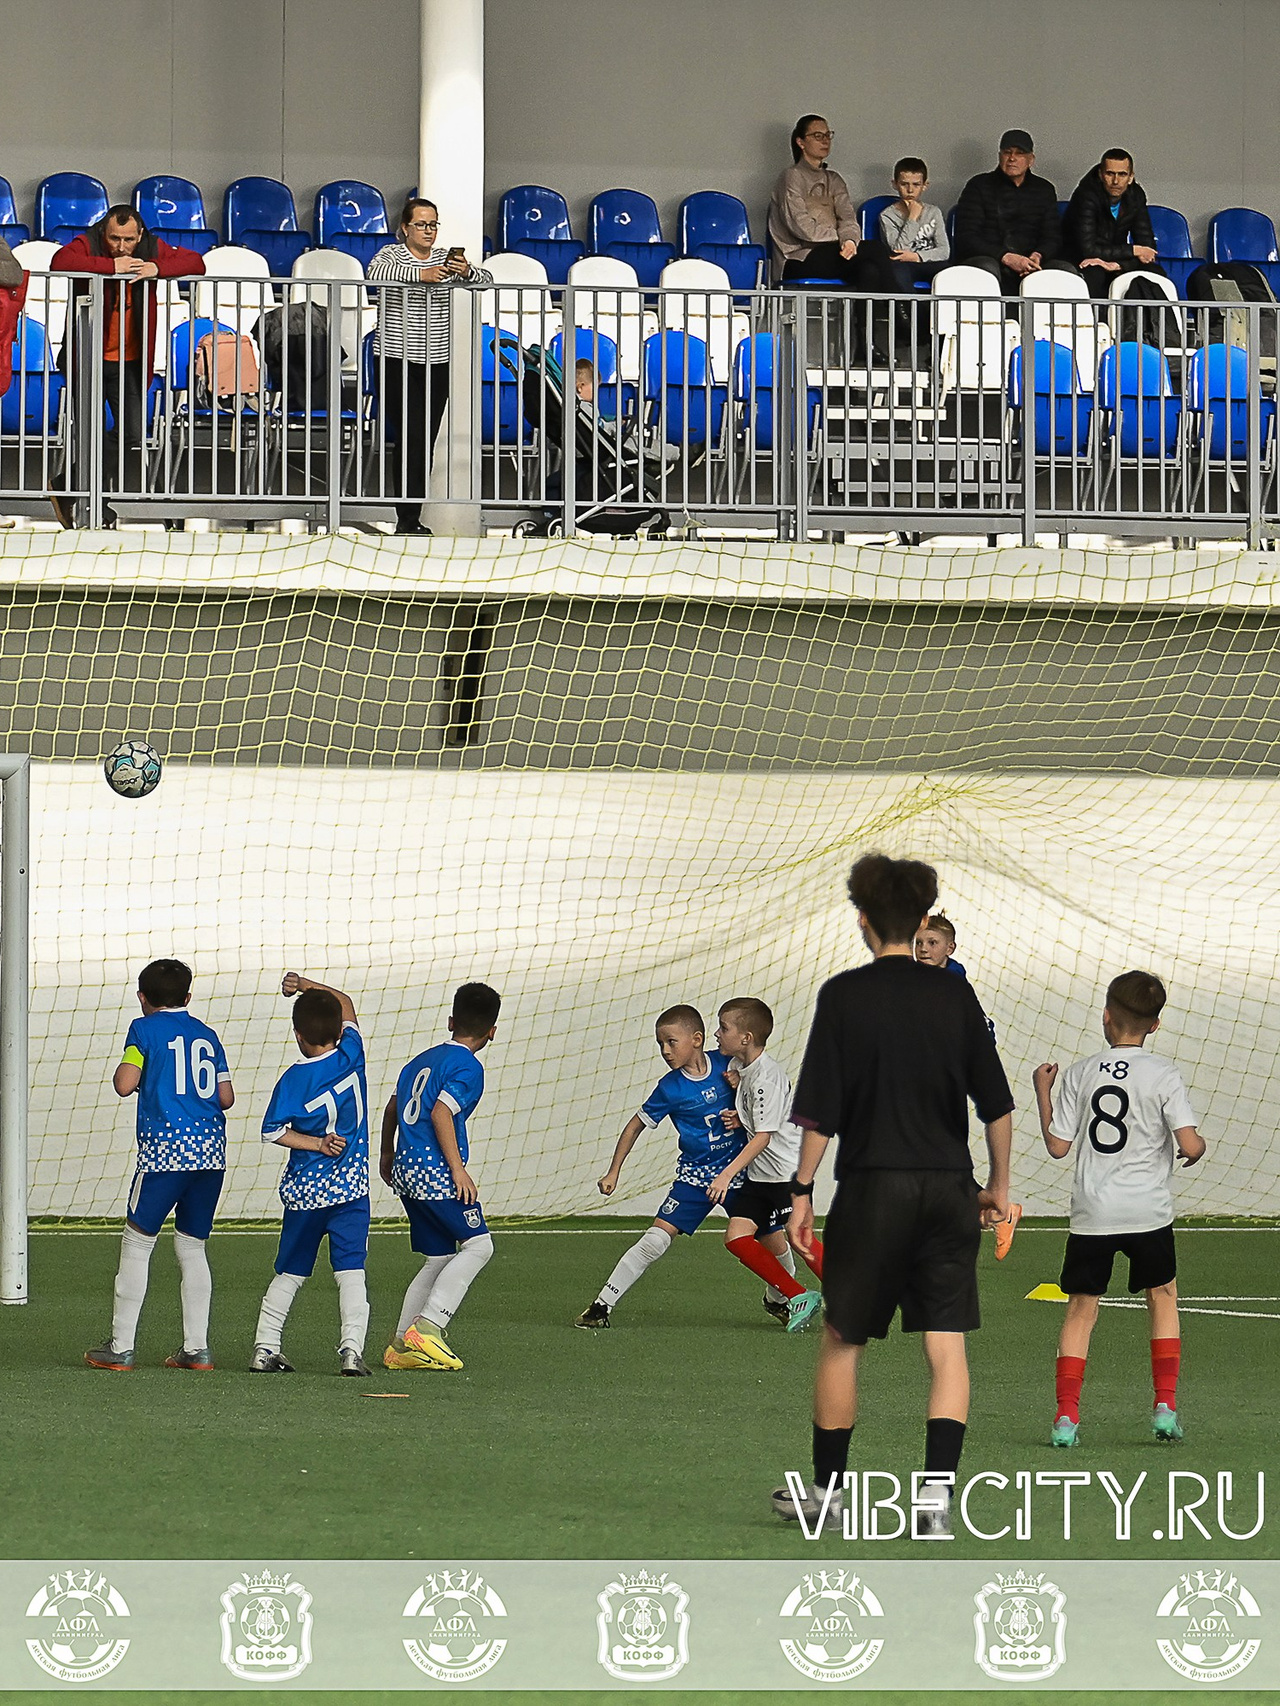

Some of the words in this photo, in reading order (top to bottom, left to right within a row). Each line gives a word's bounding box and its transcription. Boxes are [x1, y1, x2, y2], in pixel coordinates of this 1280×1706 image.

[168, 1035, 216, 1099] 16
[403, 1067, 432, 1125] 8
[304, 1070, 364, 1135] 77
[1088, 1084, 1130, 1155] 8
